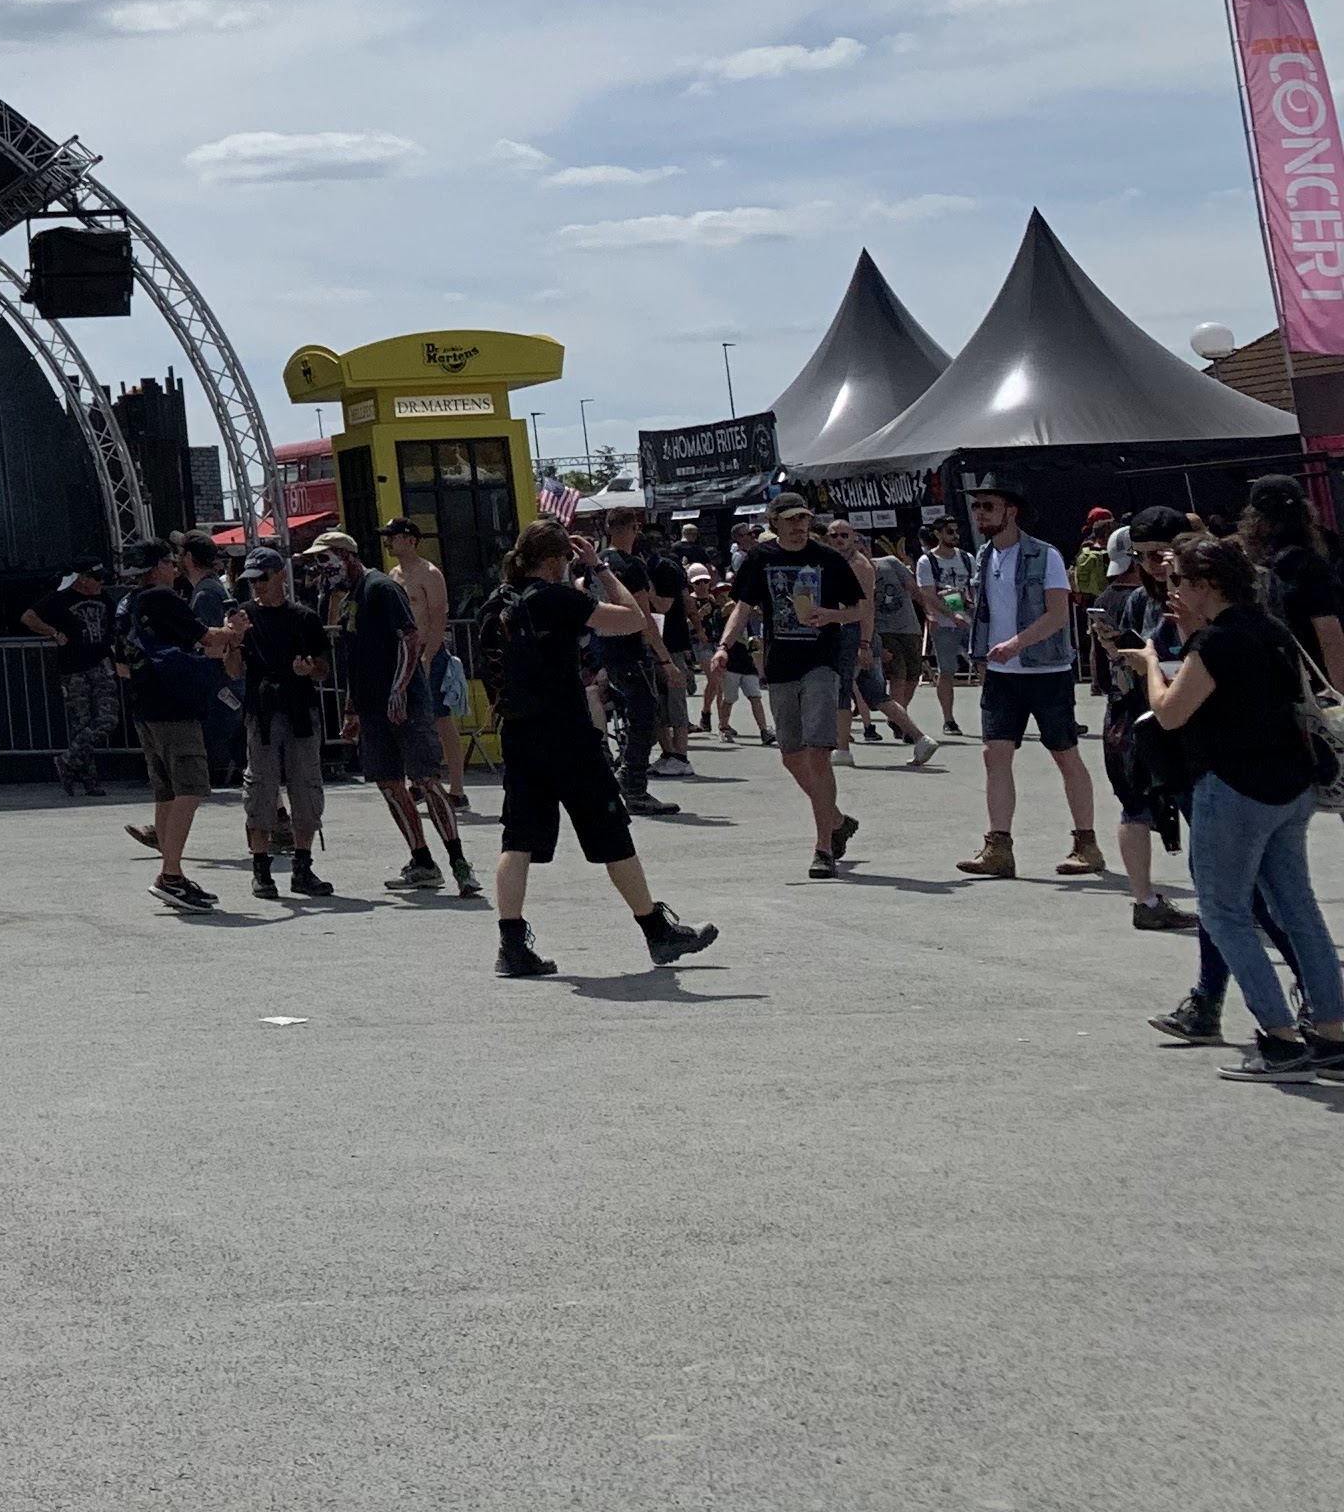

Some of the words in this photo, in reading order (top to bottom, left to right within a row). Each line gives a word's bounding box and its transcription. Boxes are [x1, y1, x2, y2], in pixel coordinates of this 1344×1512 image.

[426, 346, 480, 364] Martens
[672, 431, 714, 459] HOMARD
[715, 424, 748, 453] FRITES
[841, 479, 881, 508] CHICHI
[881, 474, 913, 505] SHOW
